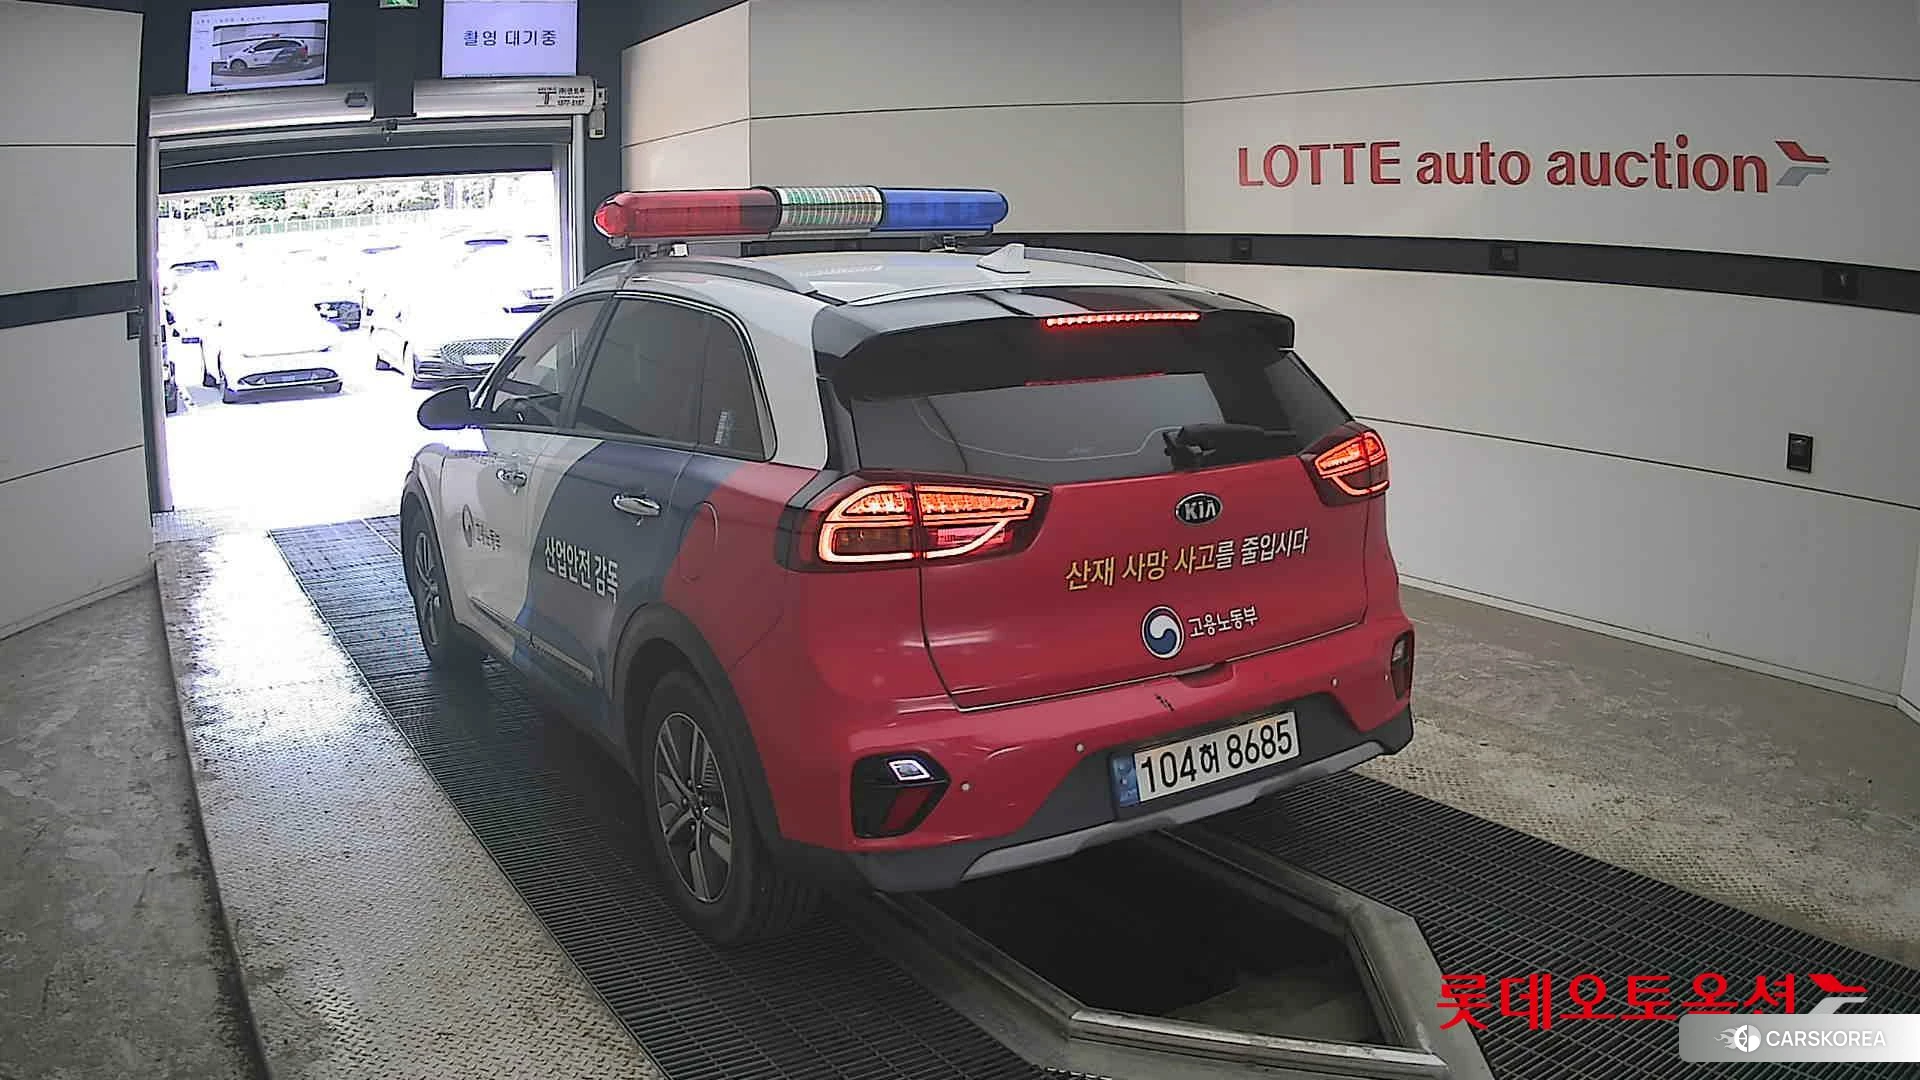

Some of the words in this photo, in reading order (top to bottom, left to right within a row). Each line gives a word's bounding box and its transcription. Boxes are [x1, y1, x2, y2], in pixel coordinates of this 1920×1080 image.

[464, 30, 497, 47] 촬영
[505, 30, 557, 47] 대기중
[1238, 142, 1400, 187] LOTTE
[1416, 142, 1531, 185] auto
[1547, 134, 1768, 193] auction
[1184, 500, 1216, 521] KIA
[545, 536, 592, 591] 산업안전
[594, 555, 618, 604] 감독
[1065, 556, 1115, 590] 산재
[1122, 550, 1168, 582] 사망
[1174, 540, 1235, 575] 사고를
[1241, 528, 1309, 566] 줄입시다
[1188, 606, 1258, 638] 고용노동부
[1141, 742, 1220, 793] 104허
[1226, 720, 1292, 769] 8685
